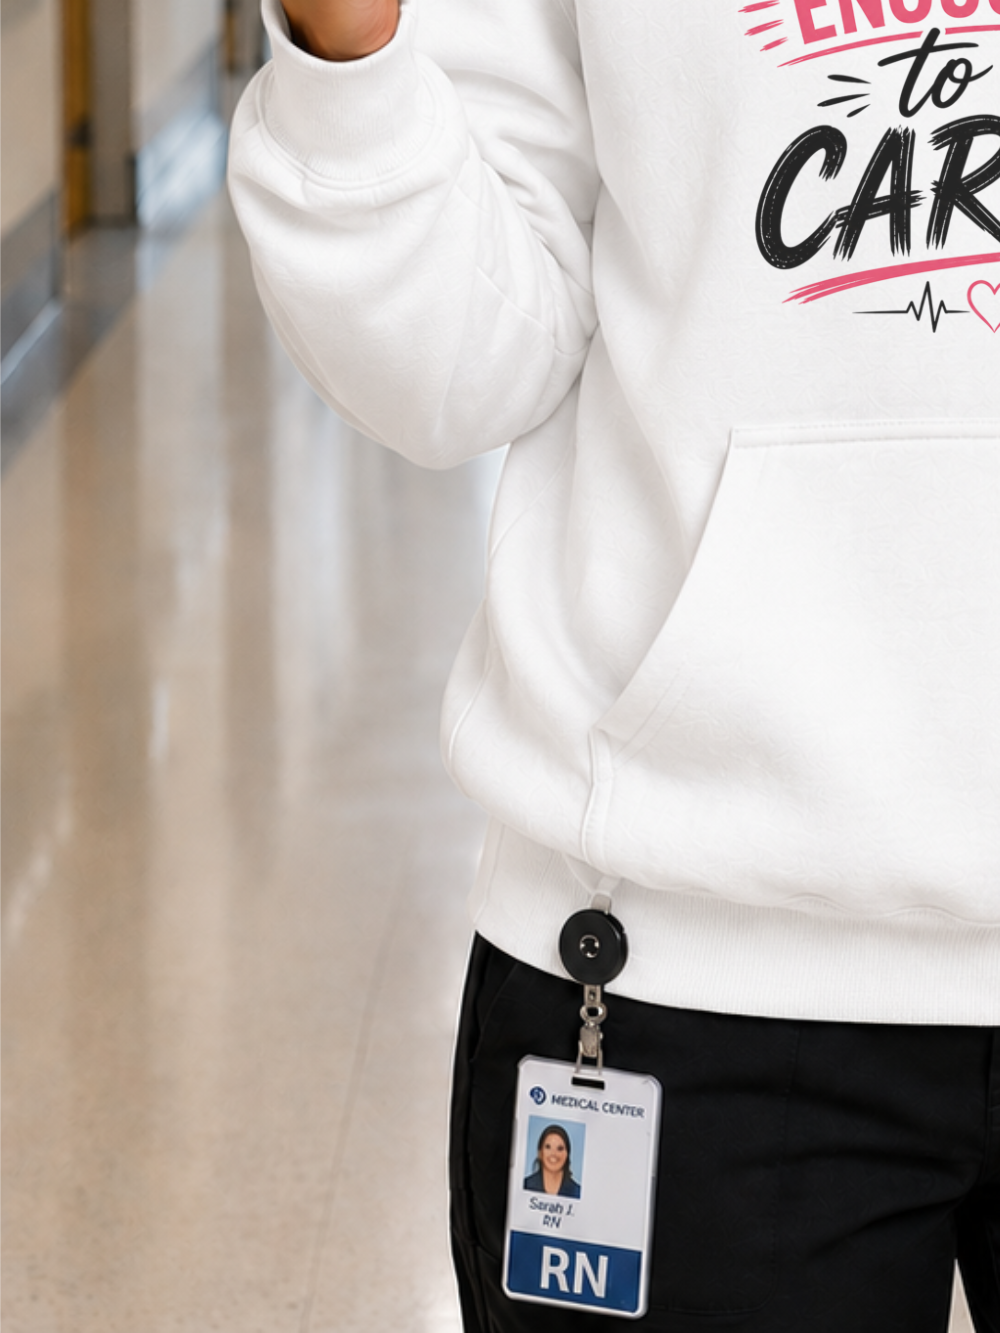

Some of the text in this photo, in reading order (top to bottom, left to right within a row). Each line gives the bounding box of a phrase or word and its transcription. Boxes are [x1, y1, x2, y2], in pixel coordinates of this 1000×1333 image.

[877, 27, 994, 118] to
[601, 1102, 645, 1118] CENTER
[529, 1197, 564, 1214] Sarah
[543, 1214, 562, 1228] RN
[540, 1245, 608, 1299] RN
